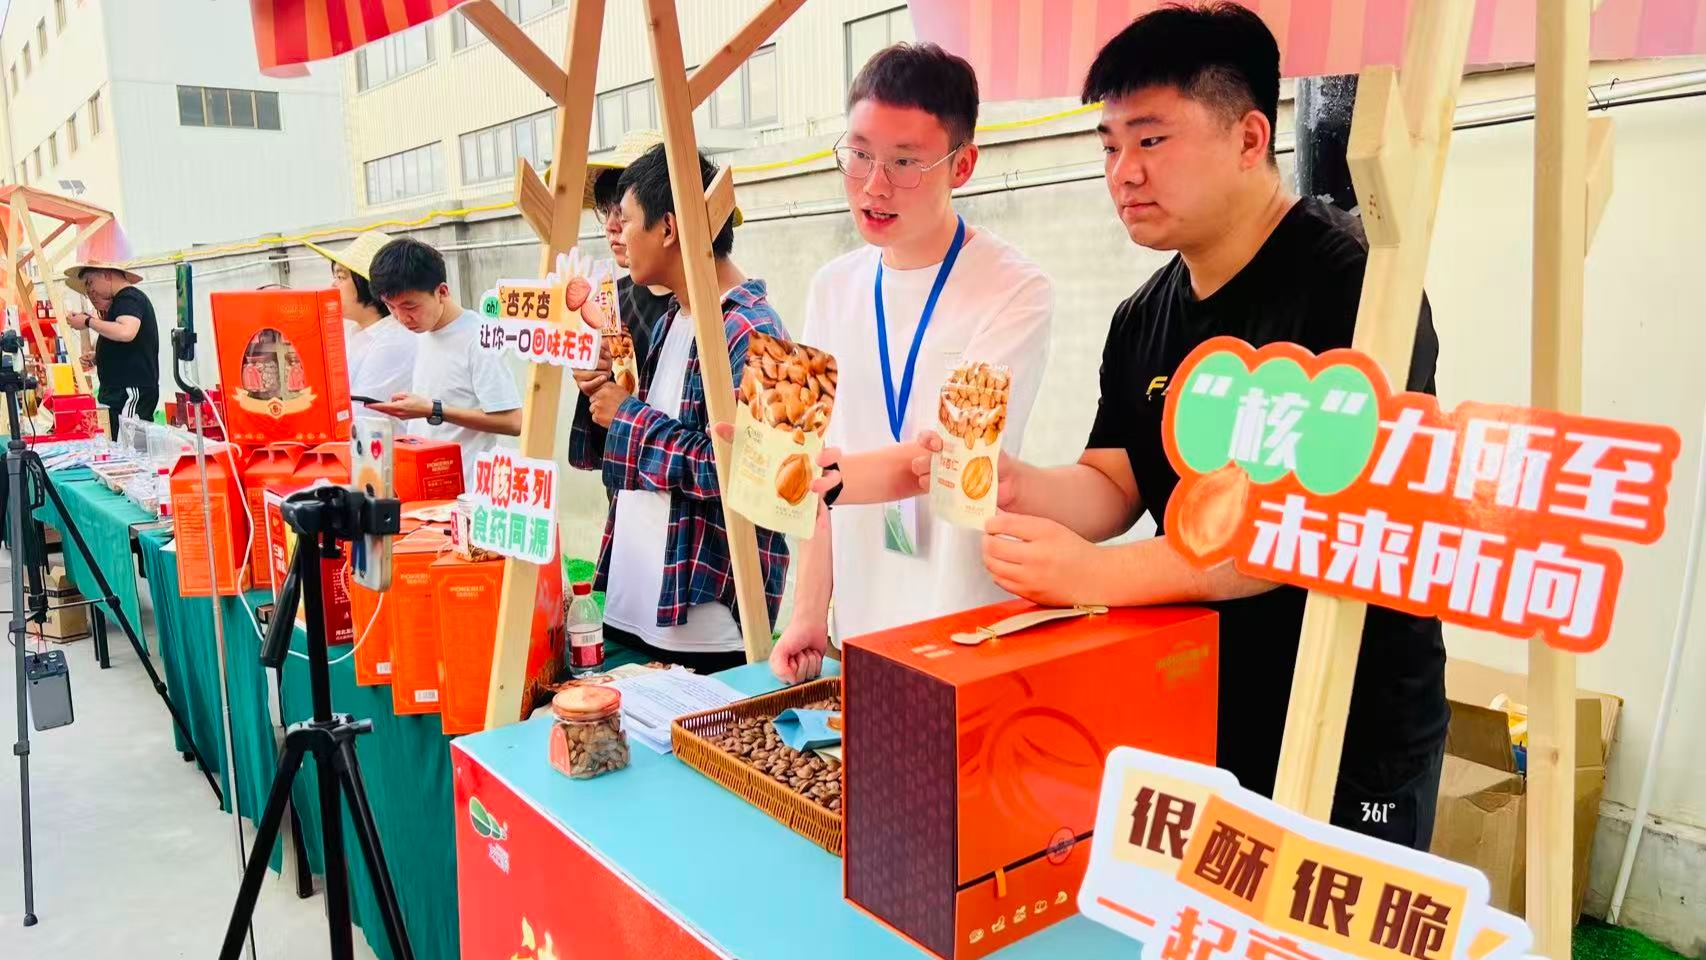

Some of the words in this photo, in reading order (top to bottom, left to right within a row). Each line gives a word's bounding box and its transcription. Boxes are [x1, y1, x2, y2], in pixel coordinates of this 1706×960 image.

[486, 300, 499, 315] oh!
[506, 289, 551, 319] 杏不杏
[480, 324, 594, 362] 让你一口回味无穷
[475, 455, 553, 510] 双核系列
[473, 504, 549, 558] 食药同源
[1248, 494, 1607, 639] 未来所向
[1129, 786, 1452, 959] 很酥很脆
